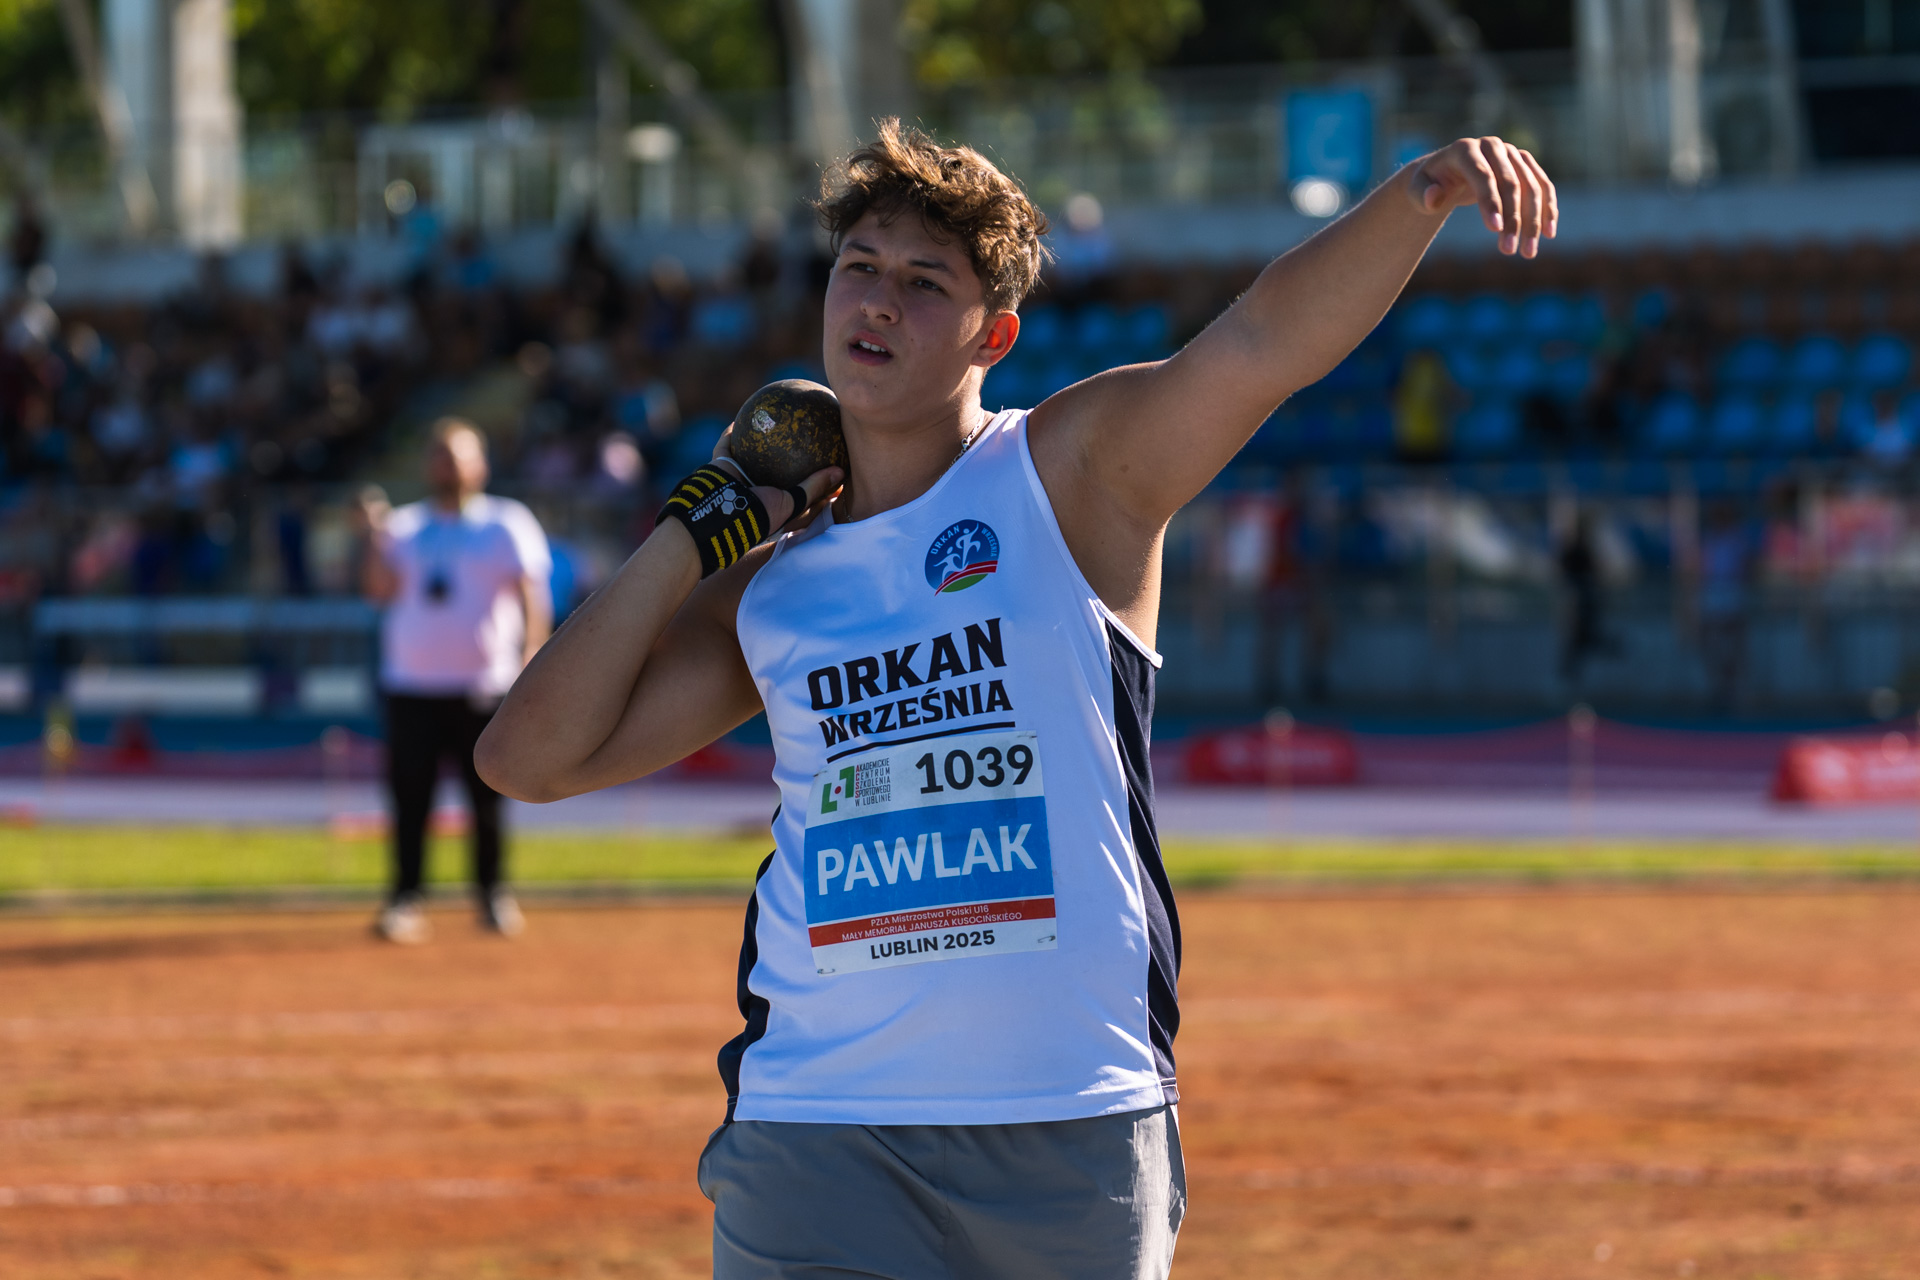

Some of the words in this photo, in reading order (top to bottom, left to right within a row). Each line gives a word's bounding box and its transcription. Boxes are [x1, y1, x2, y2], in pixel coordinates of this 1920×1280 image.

[691, 494, 724, 522] OLIMP
[930, 524, 960, 555] ORKAN
[807, 617, 1007, 711] ORKAN
[818, 679, 1014, 748] WRZEŚNIA
[855, 757, 890, 773] AKADEMICKIE
[855, 766, 891, 782] CENTRUM
[915, 744, 1034, 794] 1039
[855, 775, 891, 790] SZKOLENIA
[855, 784, 891, 799] SPORTOWEGO
[855, 798, 860, 807] W
[862, 792, 891, 806] LUBLINIE
[817, 823, 1038, 895] PAWLAK
[841, 930, 864, 941] MAŁY
[864, 924, 907, 938] MEMORIAŁ
[909, 919, 950, 932] JANUSZA
[951, 911, 1022, 926] KUSOCIŃSKIEGO
[870, 917, 890, 927] PZLA
[891, 911, 944, 924] Mistrzostwa
[946, 906, 972, 917] Polski
[973, 904, 989, 914] U16
[870, 936, 939, 960] LUBLIN
[943, 929, 996, 950] 2025
